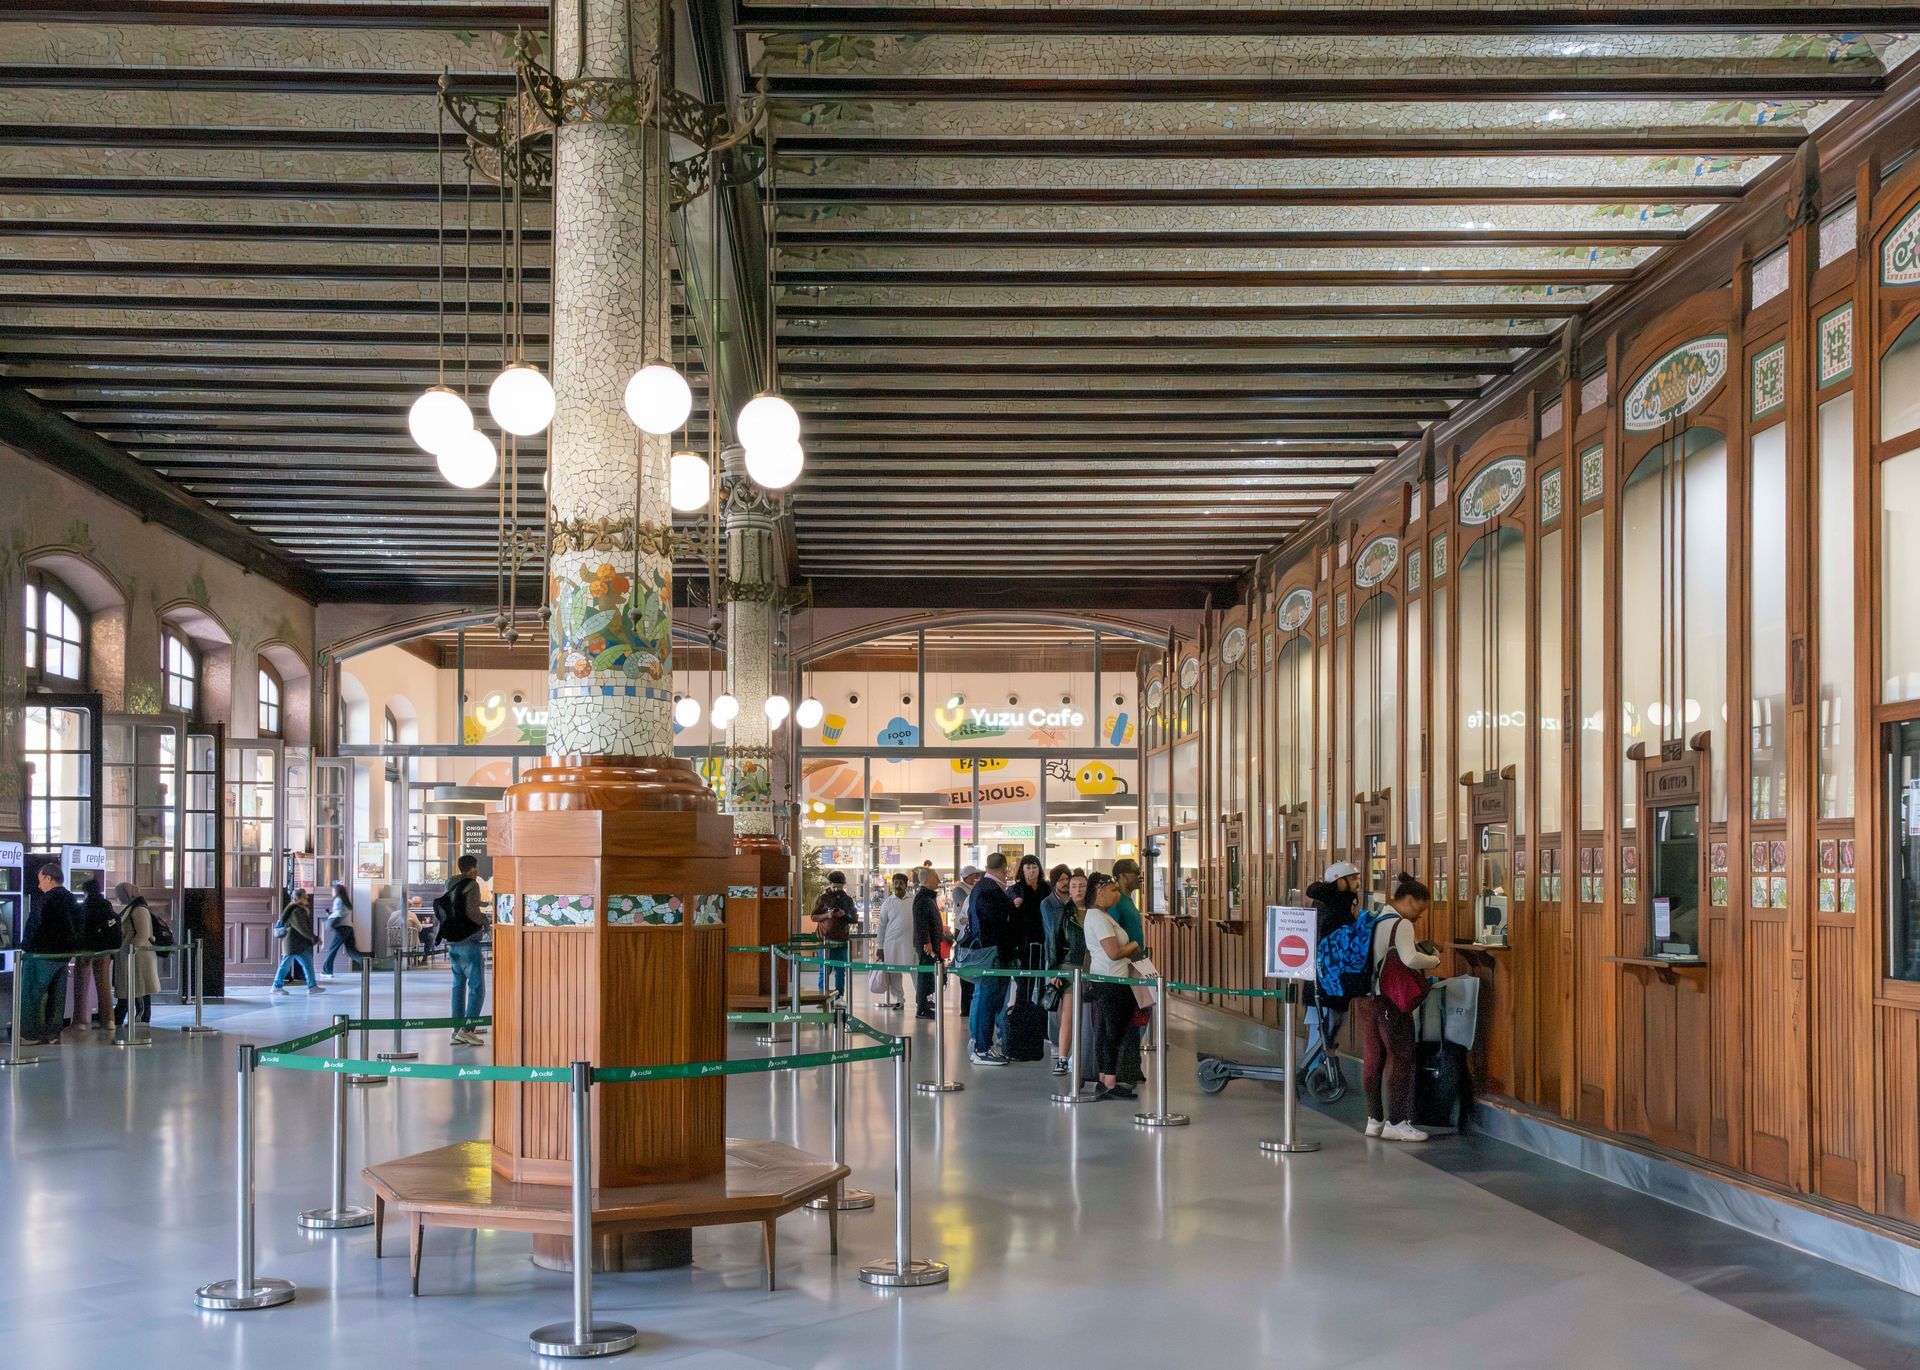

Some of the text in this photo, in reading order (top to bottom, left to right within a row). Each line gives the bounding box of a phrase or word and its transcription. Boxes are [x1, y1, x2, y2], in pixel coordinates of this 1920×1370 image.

[970, 708, 1084, 727] Yuzu Cafe
[888, 730, 911, 740] FOOD
[948, 786, 1030, 804] ELICIOUS.
[1658, 811, 1669, 842] 7
[1372, 836, 1377, 857] 5
[1482, 826, 1489, 851] 6
[86, 850, 104, 867] renfe
